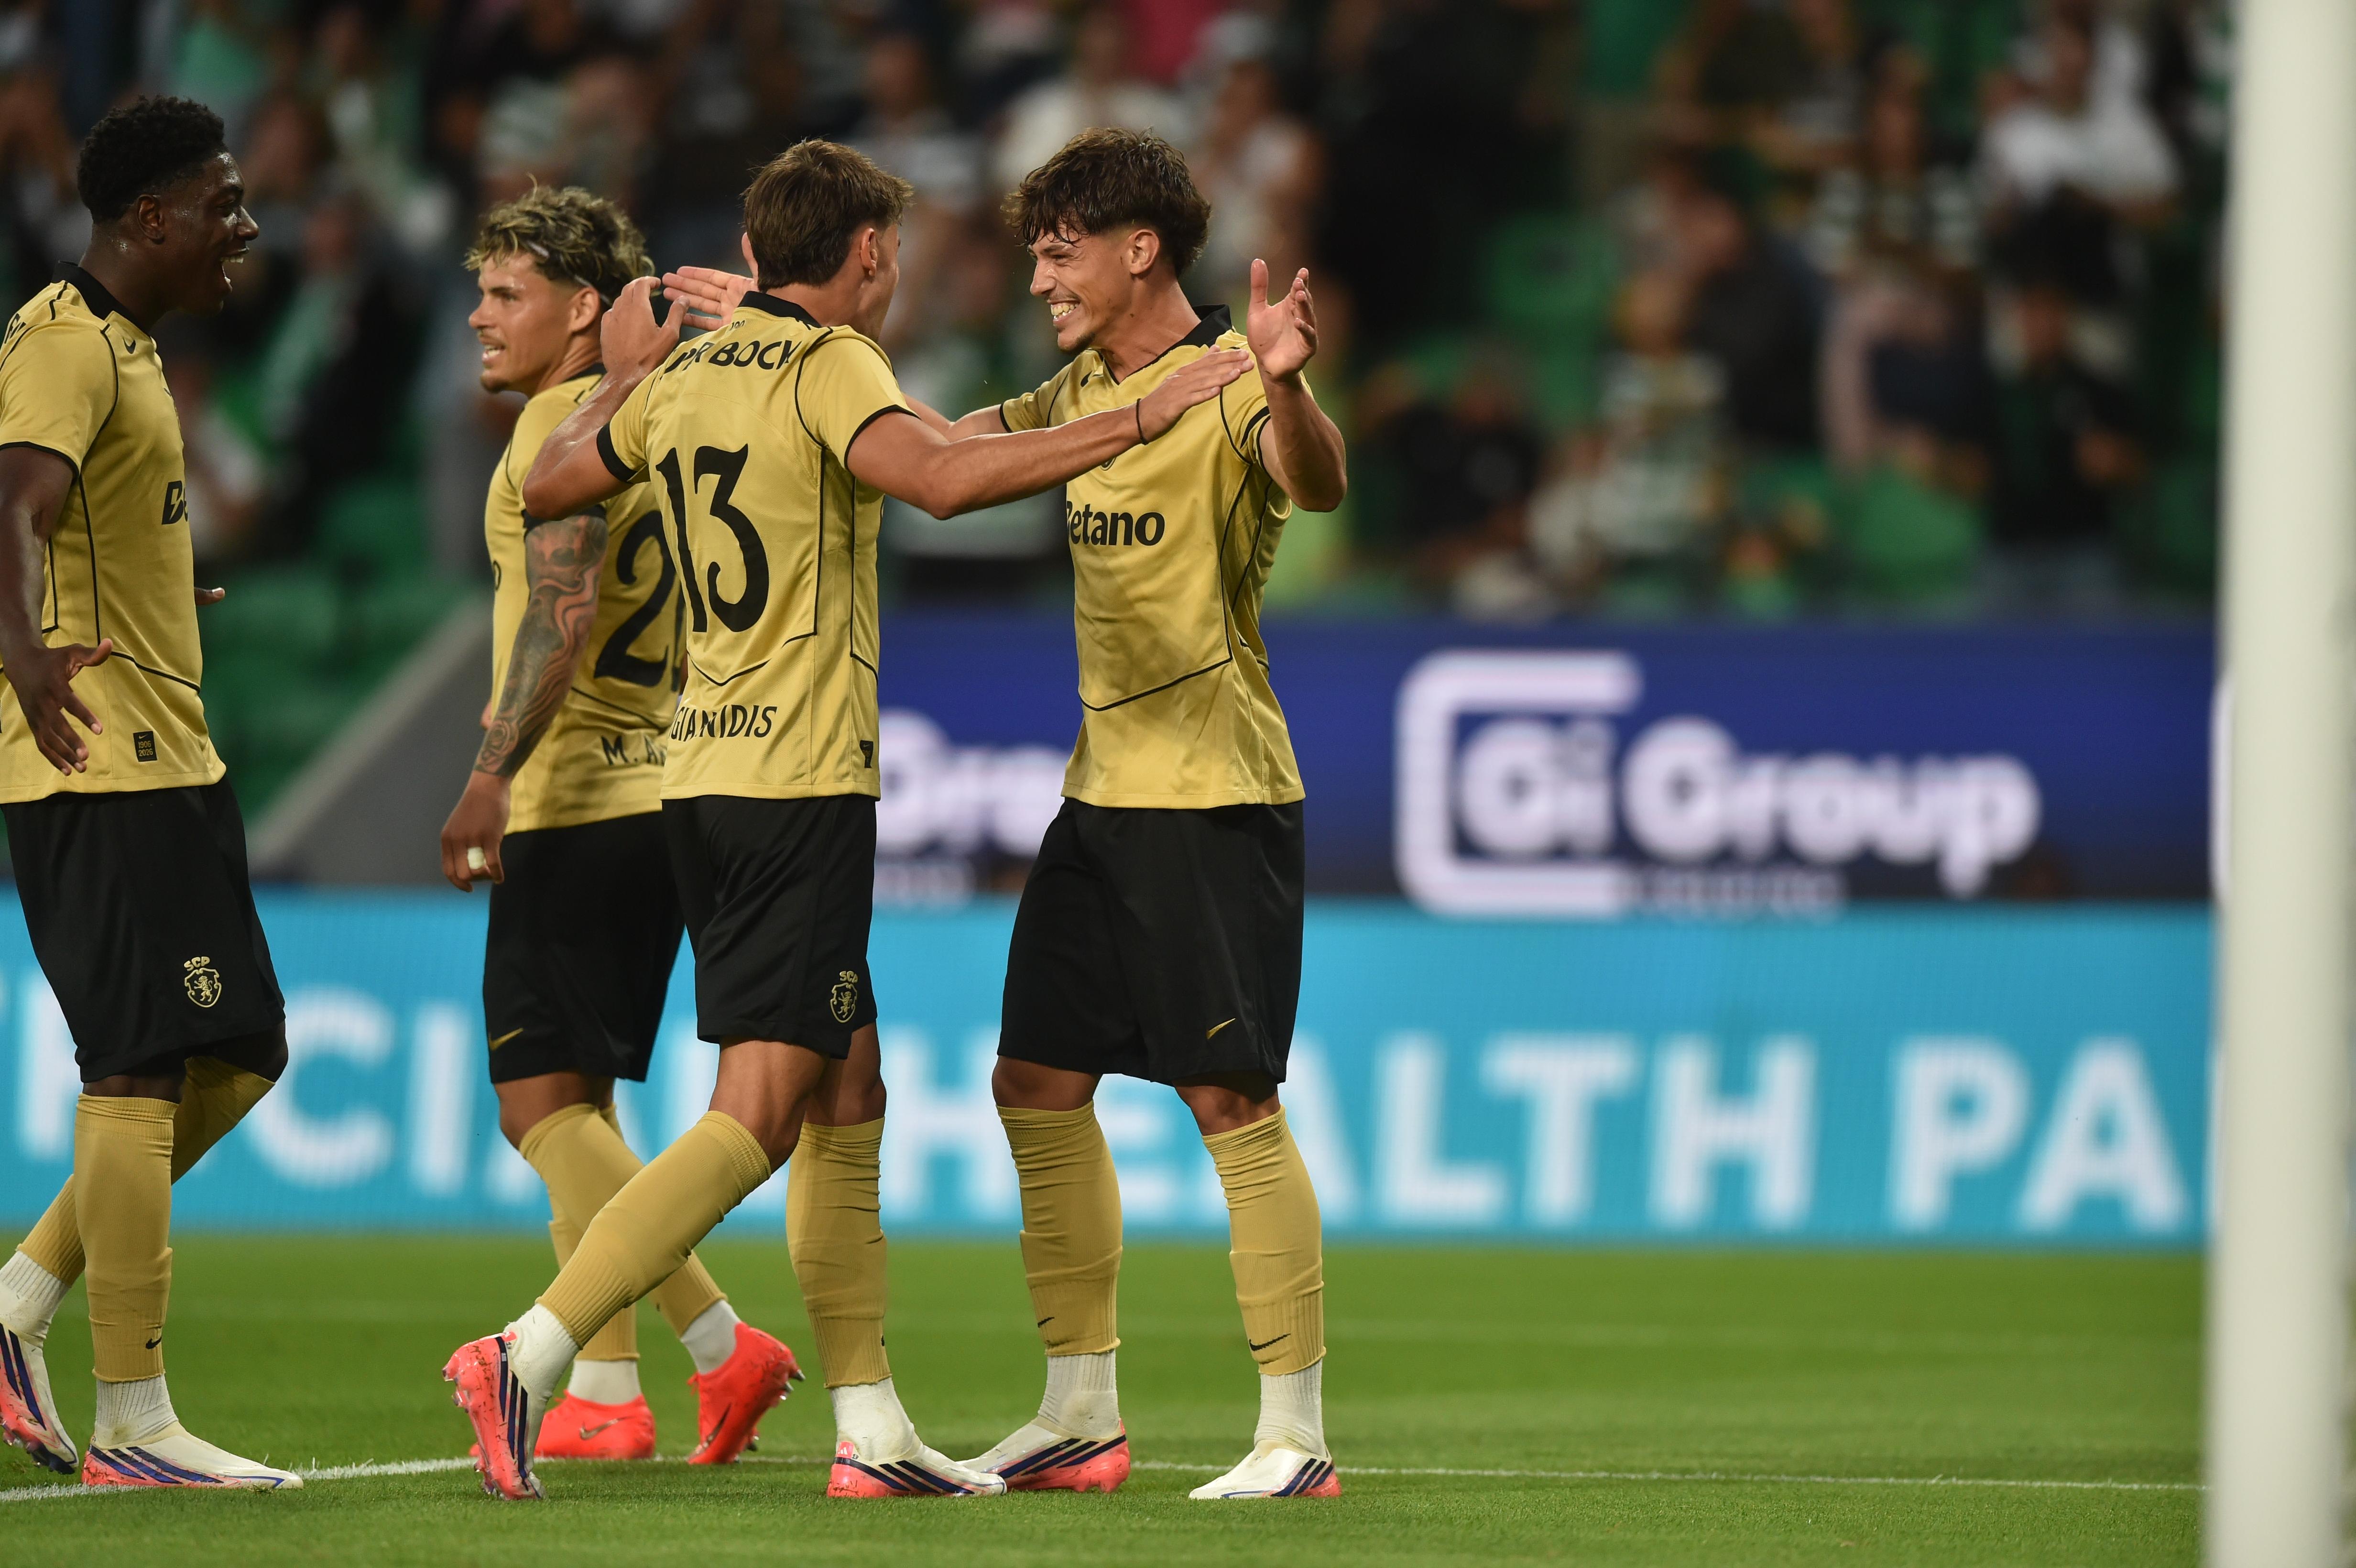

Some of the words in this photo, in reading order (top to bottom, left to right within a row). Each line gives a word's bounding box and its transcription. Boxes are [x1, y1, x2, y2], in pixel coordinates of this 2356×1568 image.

[593, 511, 687, 691] 2
[655, 444, 769, 632] 13
[138, 748, 153, 757] 2026
[1622, 716, 2044, 899] Group
[184, 956, 210, 971] SCP
[1886, 1032, 2225, 1233] PA
